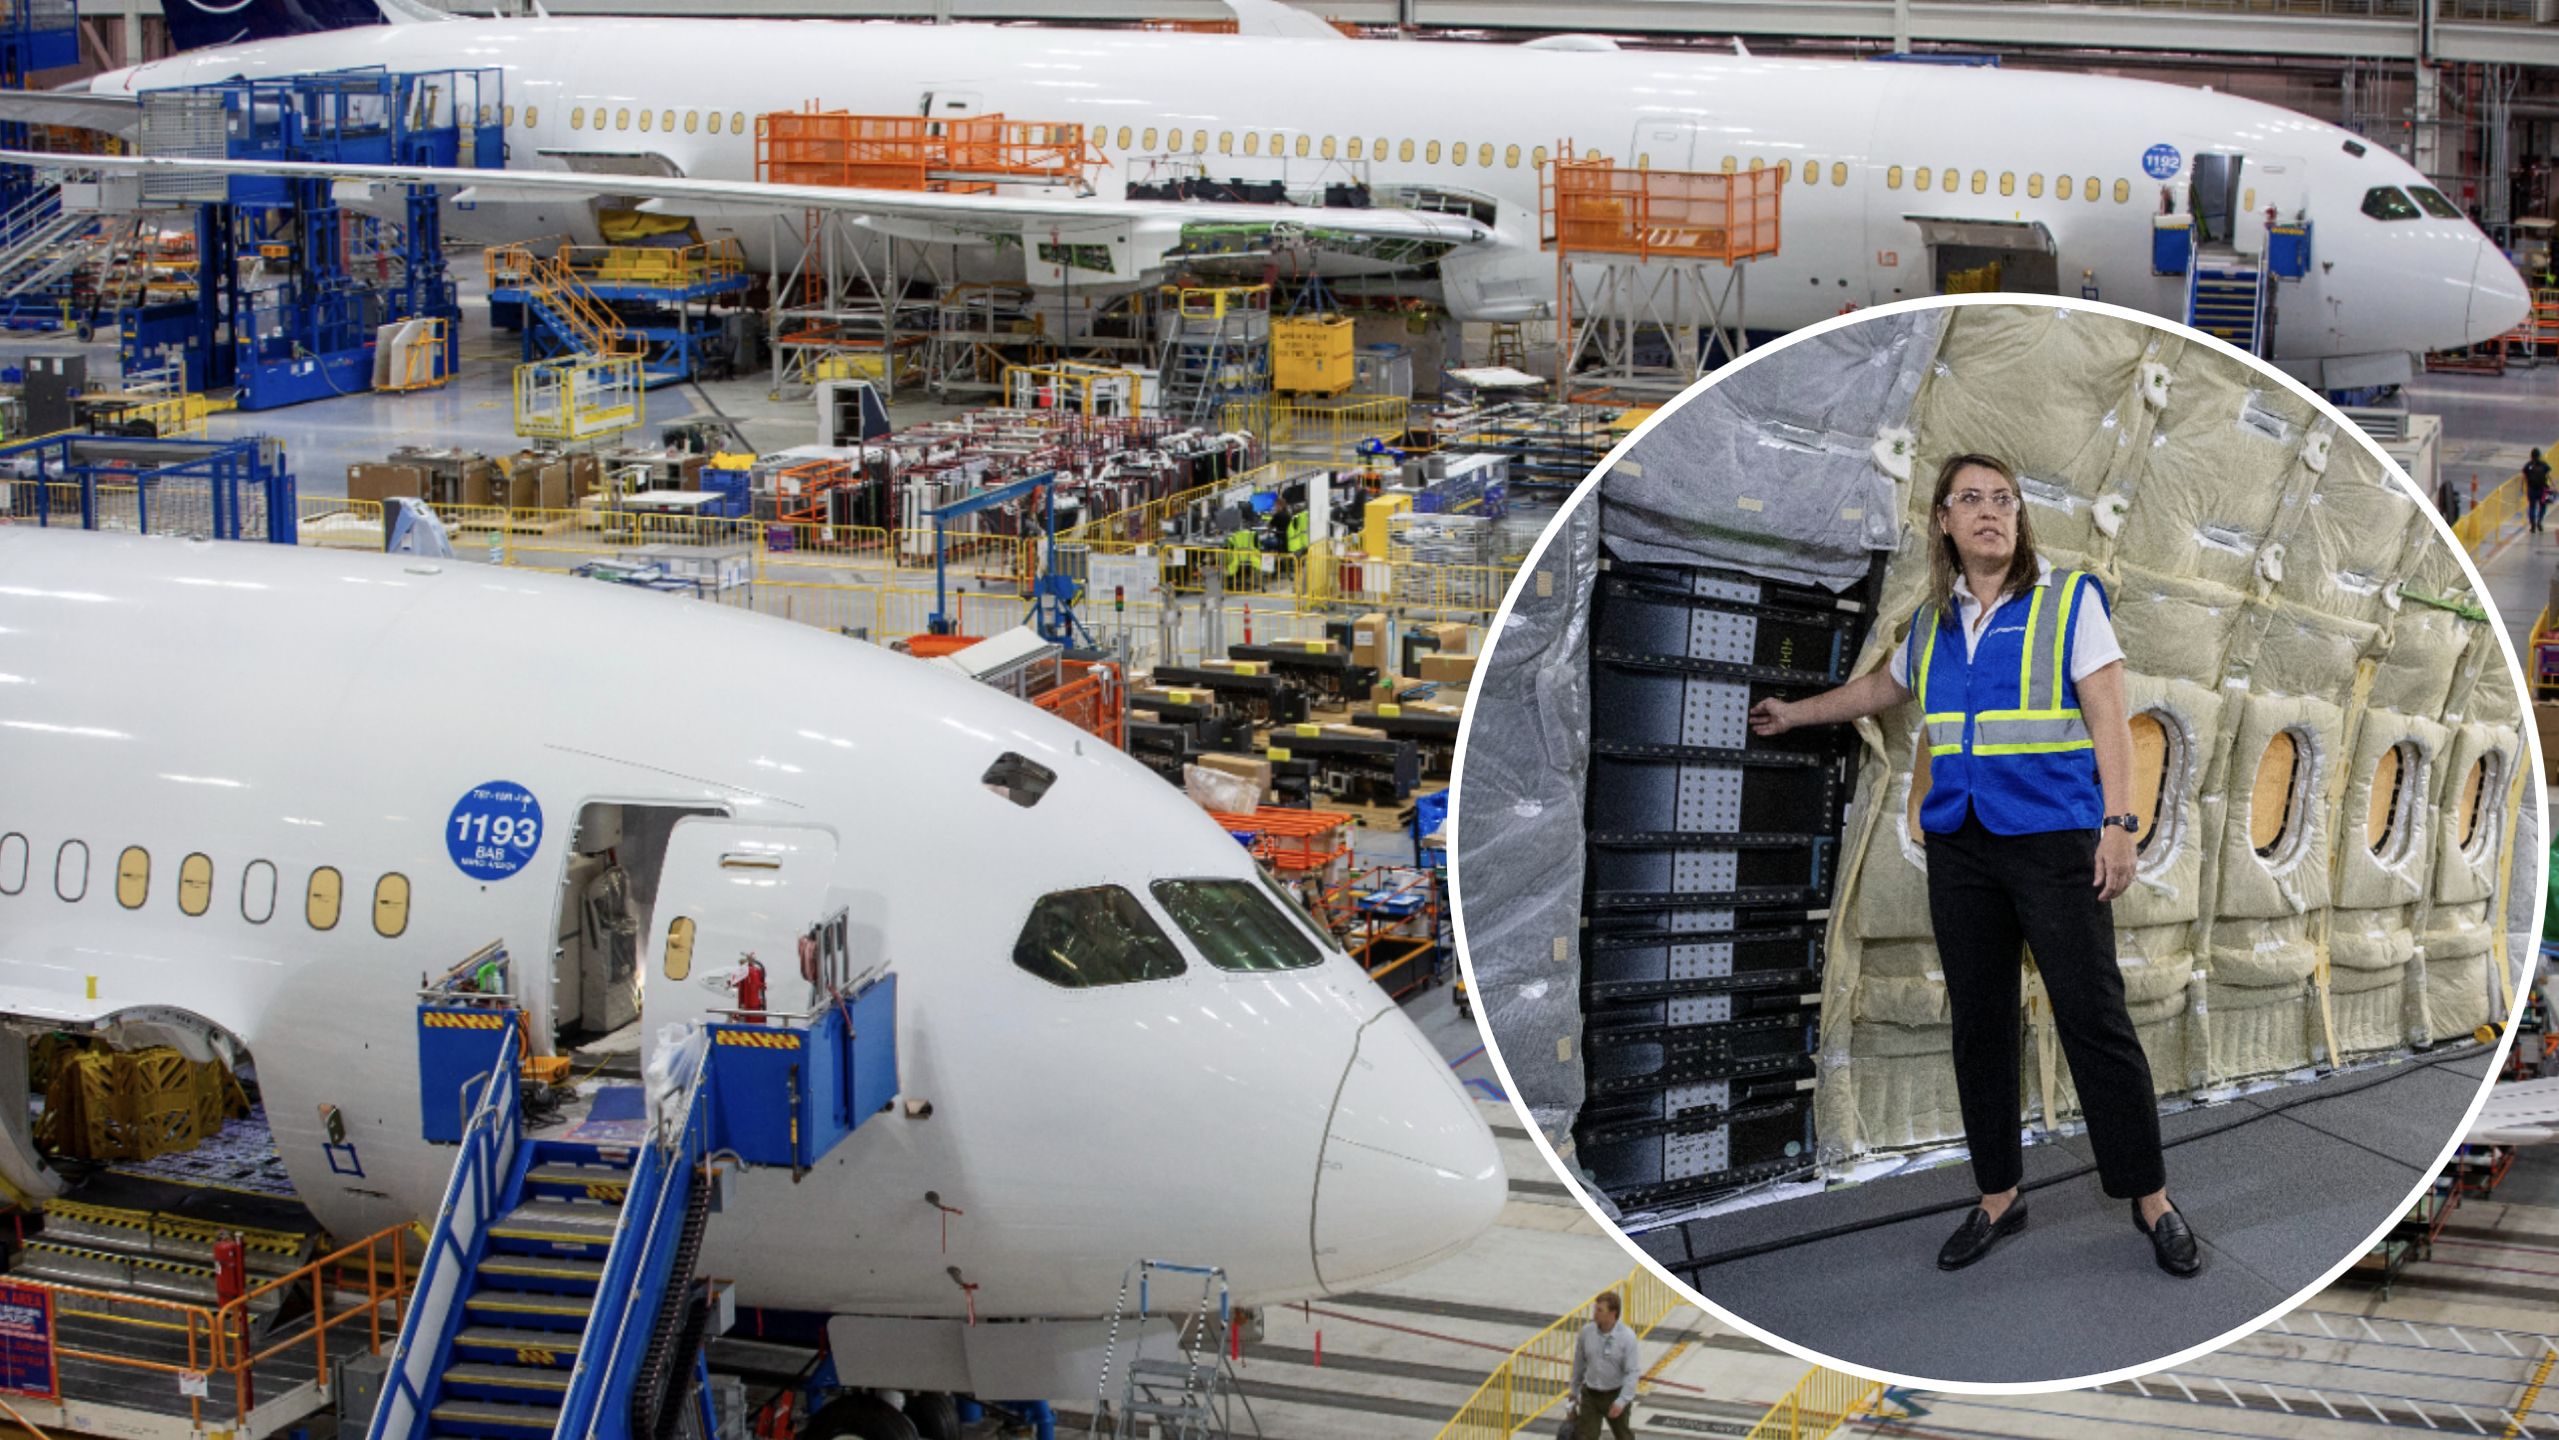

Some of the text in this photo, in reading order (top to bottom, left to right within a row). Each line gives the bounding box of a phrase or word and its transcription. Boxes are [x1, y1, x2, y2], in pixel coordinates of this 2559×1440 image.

[2146, 154, 2179, 168] 1192
[455, 812, 537, 848] 1193
[475, 845, 505, 861] BAB
